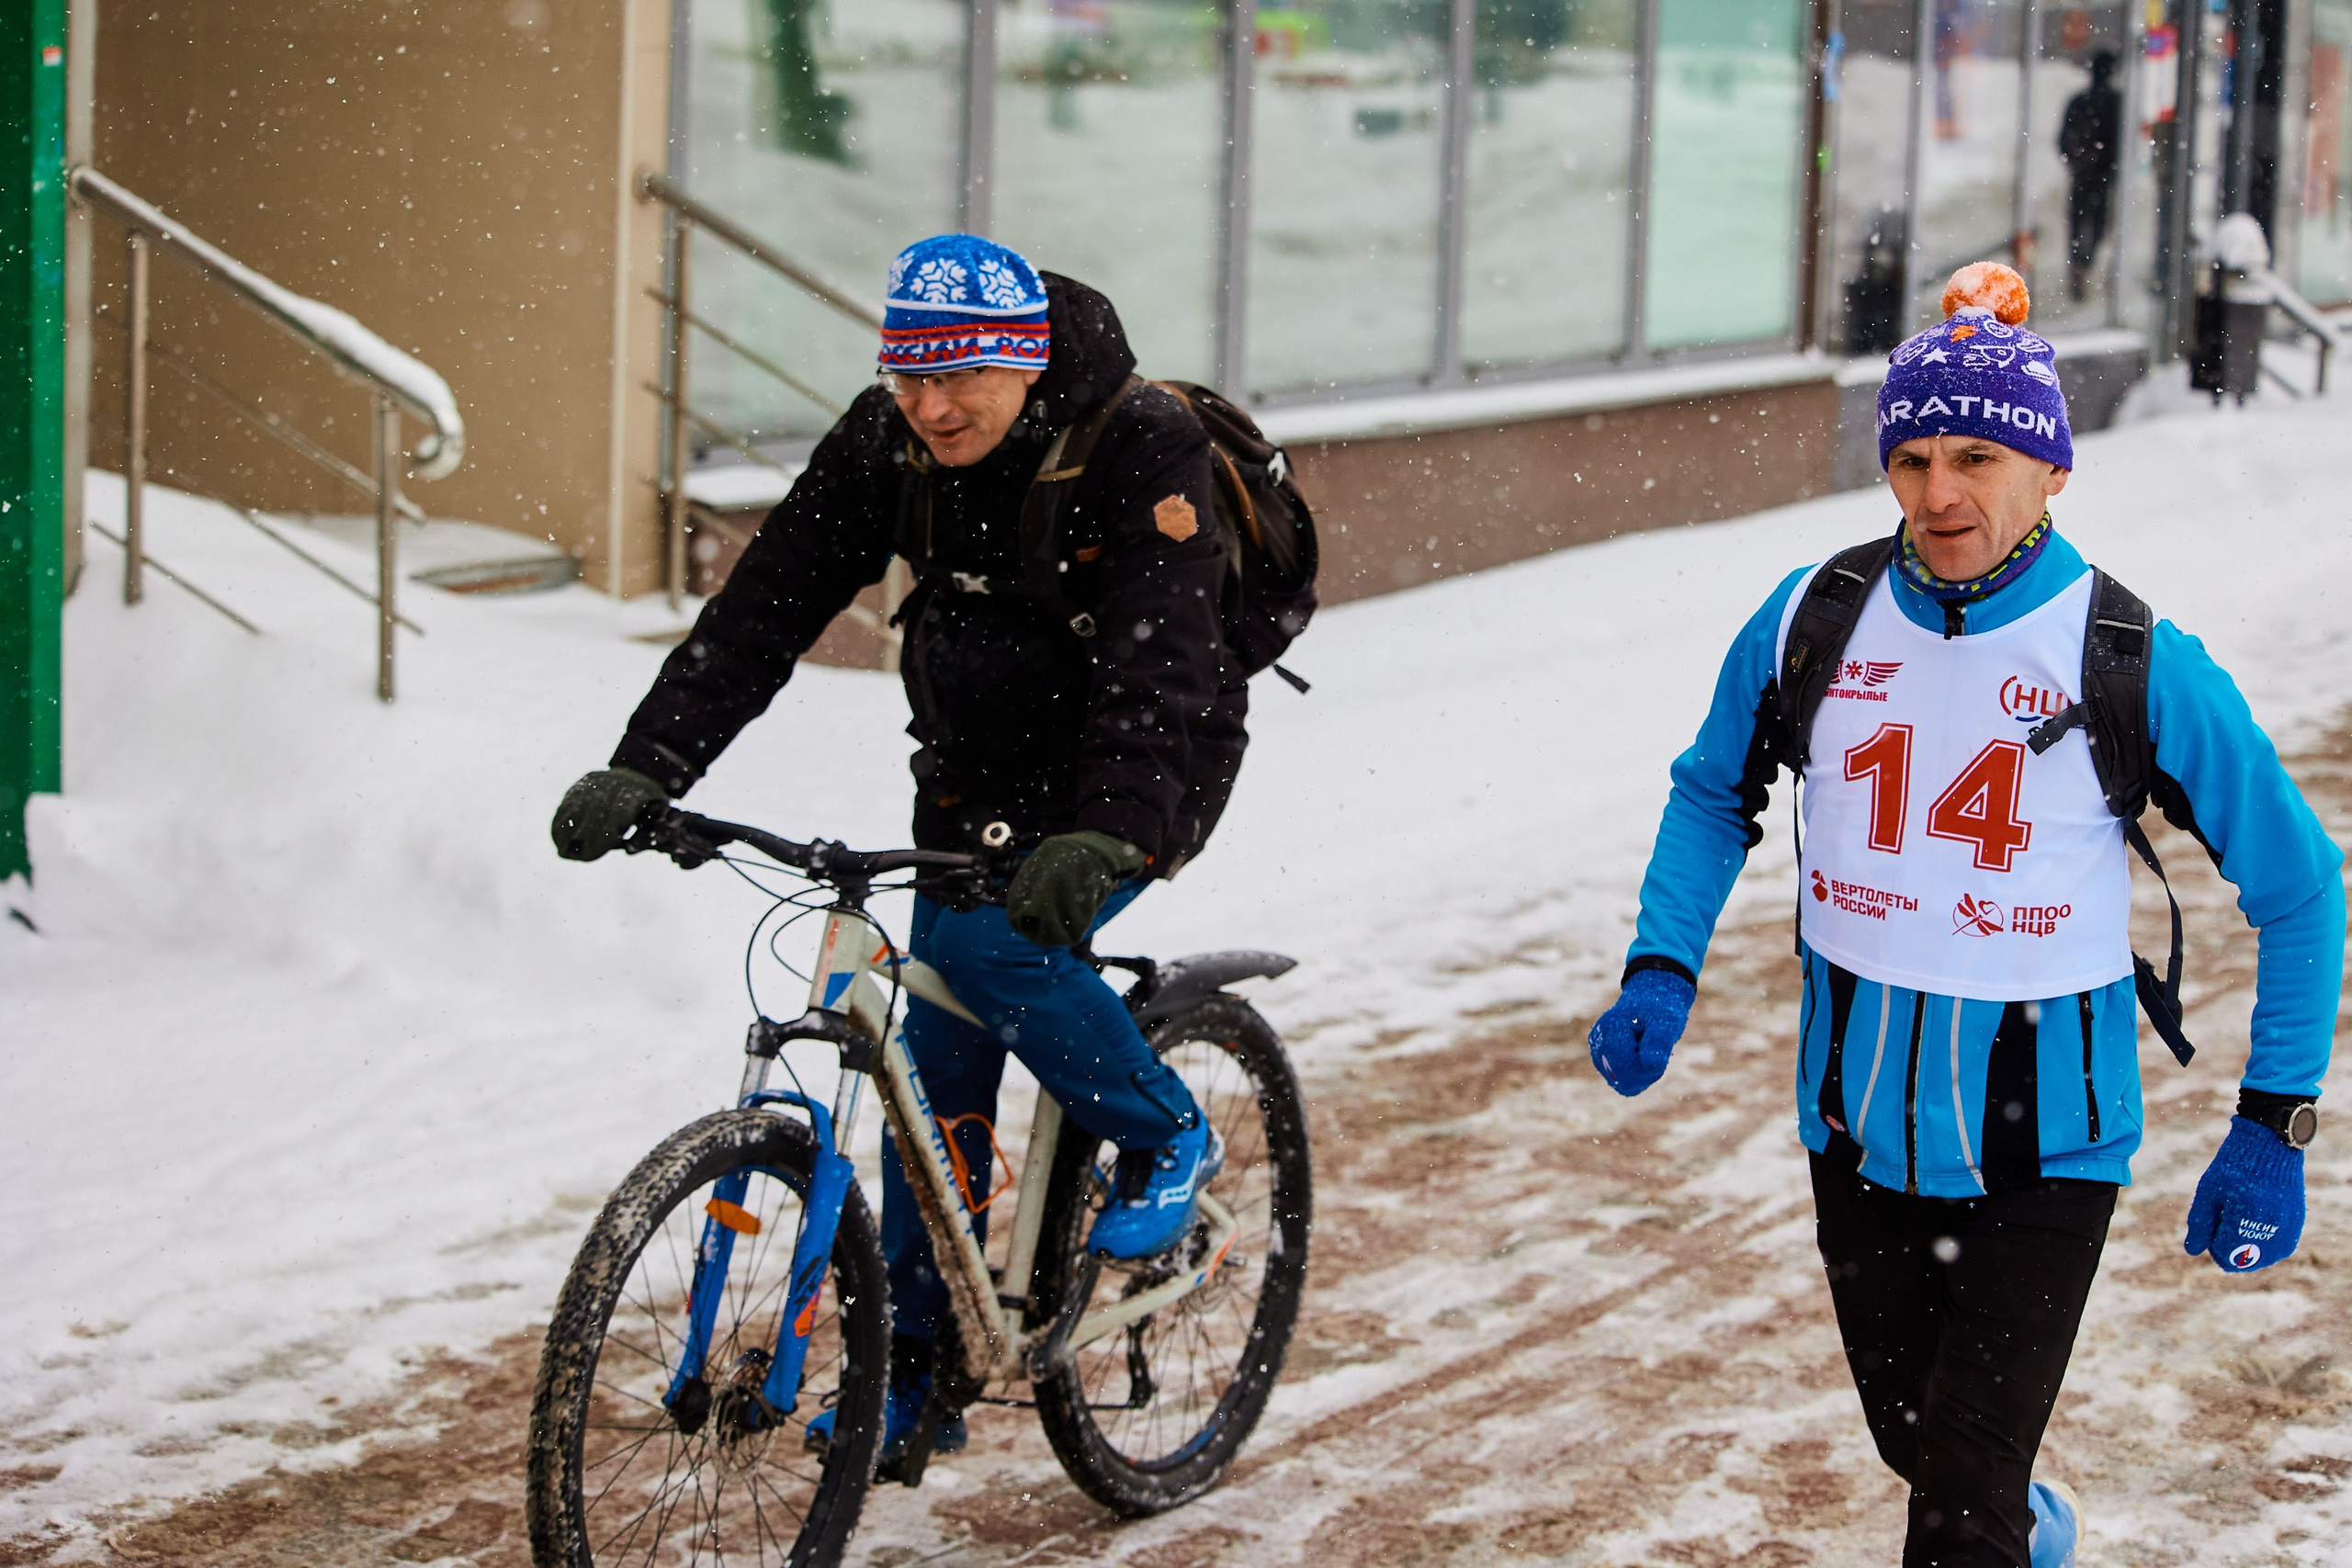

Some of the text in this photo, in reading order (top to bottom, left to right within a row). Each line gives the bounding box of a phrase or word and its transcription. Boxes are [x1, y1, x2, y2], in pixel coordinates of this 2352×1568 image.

[880, 337, 980, 365] ОССИИ
[1878, 395, 2056, 441] ARATHON
[2013, 683, 2073, 717] НЦ
[1844, 722, 2032, 873] 14
[1831, 879, 1918, 911] ВЕРТОЛЕТЫ
[1833, 894, 1886, 920] РОССИИ
[2013, 904, 2072, 920] ППОО
[2012, 921, 2056, 938] НЦВ
[2238, 1227, 2275, 1241] ДОРОГА
[2240, 1218, 2279, 1233] ЖИЗНИ
